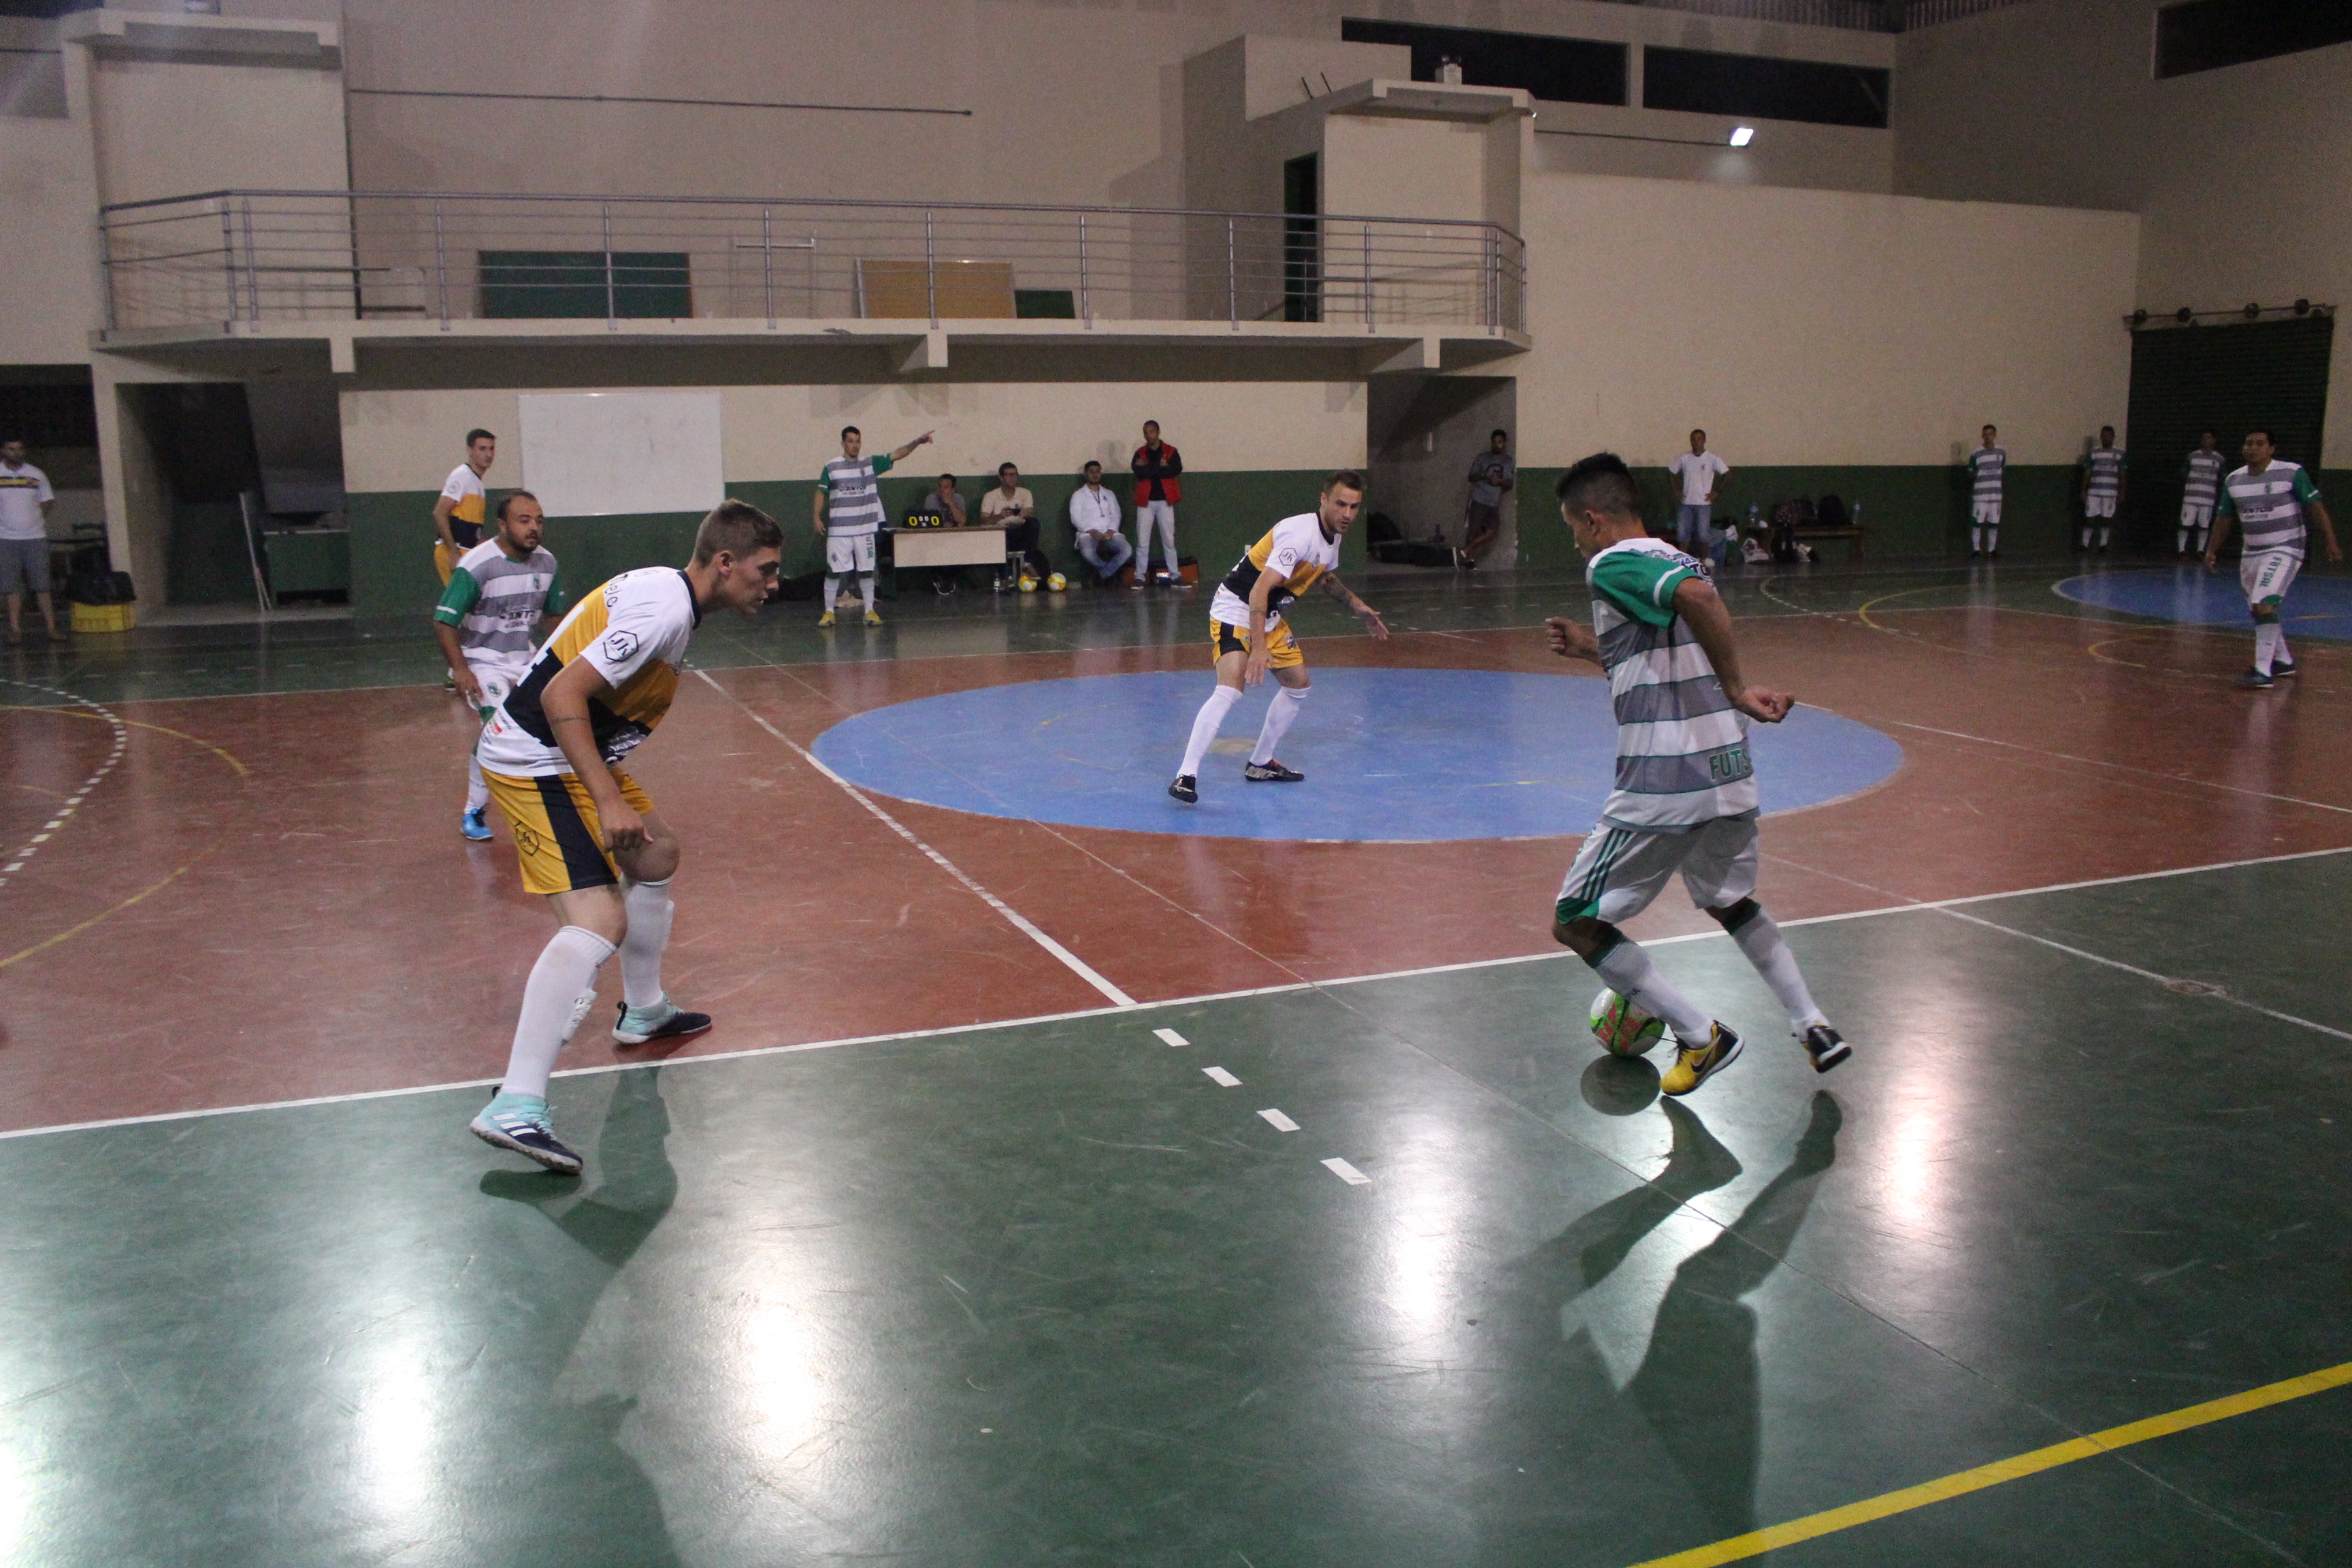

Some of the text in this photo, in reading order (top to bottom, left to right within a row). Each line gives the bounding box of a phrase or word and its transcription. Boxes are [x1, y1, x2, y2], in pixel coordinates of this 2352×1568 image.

[909, 516, 918, 526] 0
[930, 516, 940, 526] 0
[1282, 551, 1295, 562] JK
[610, 637, 634, 658] JK
